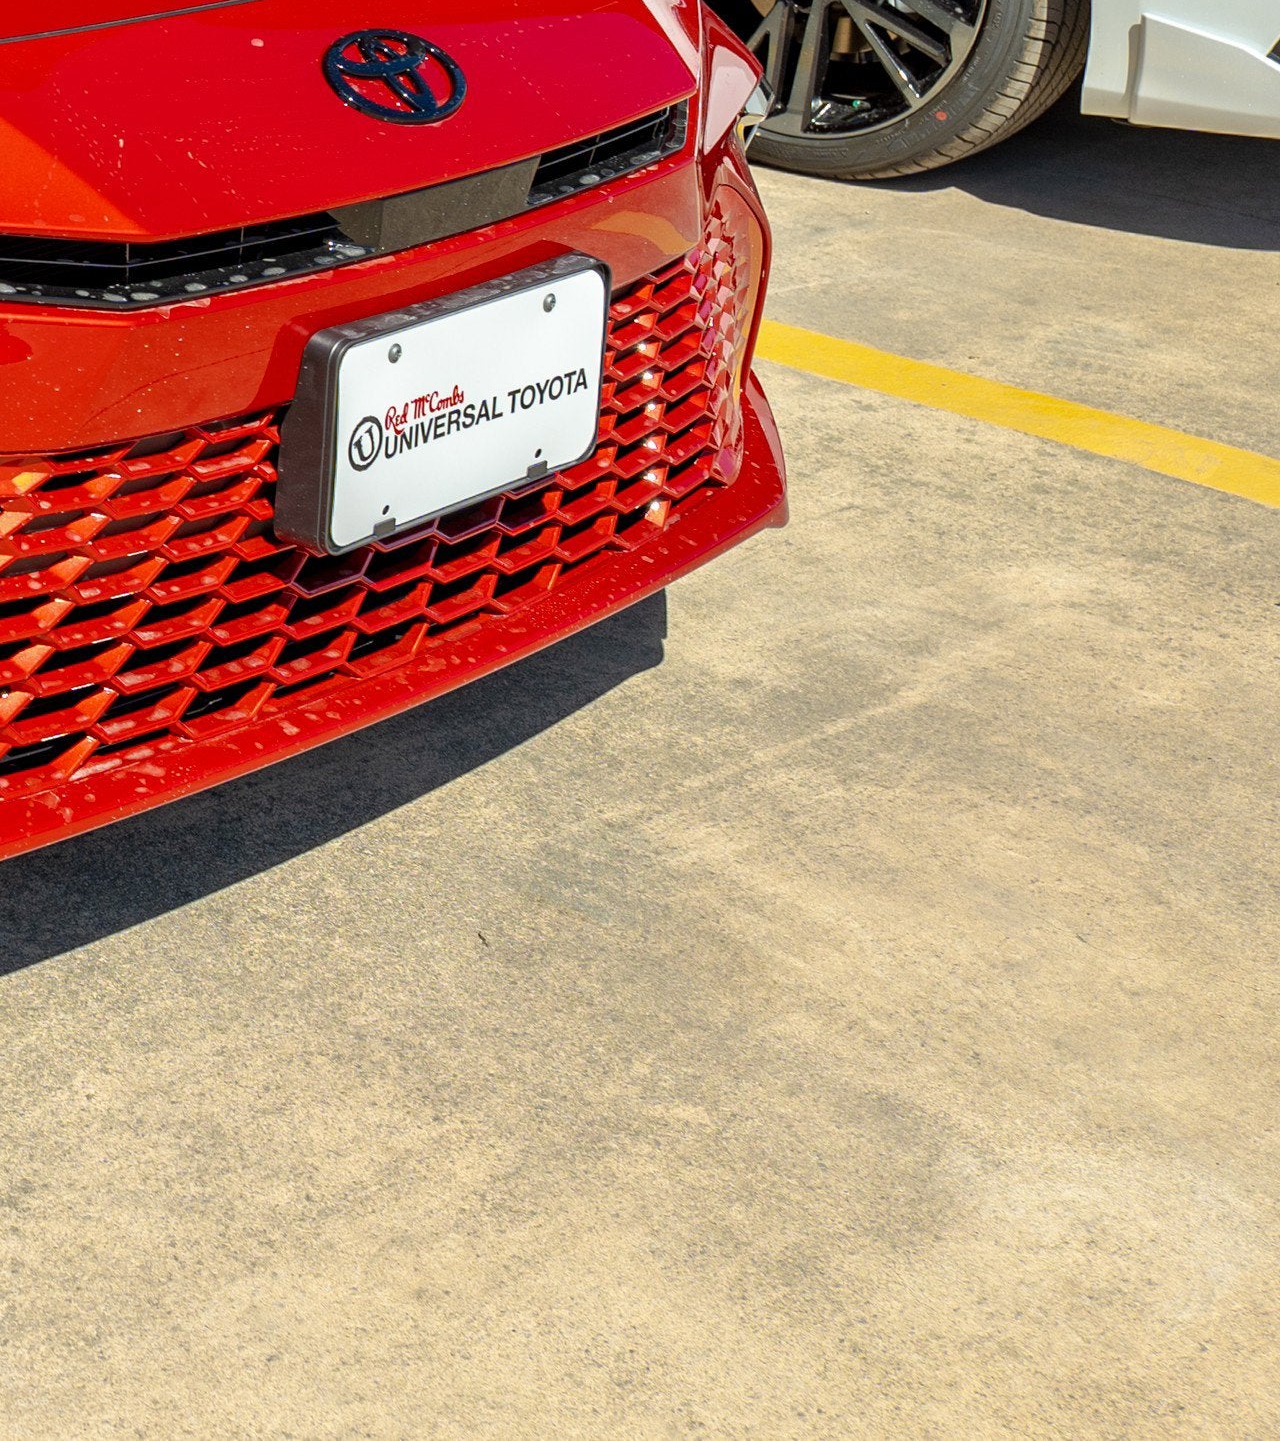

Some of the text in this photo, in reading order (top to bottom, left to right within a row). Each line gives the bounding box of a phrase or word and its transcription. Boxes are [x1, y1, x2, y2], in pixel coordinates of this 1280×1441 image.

[384, 384, 464, 436] Red McCombs
[384, 397, 503, 459] UNIVERSAL
[507, 367, 588, 414] TOYOTA
